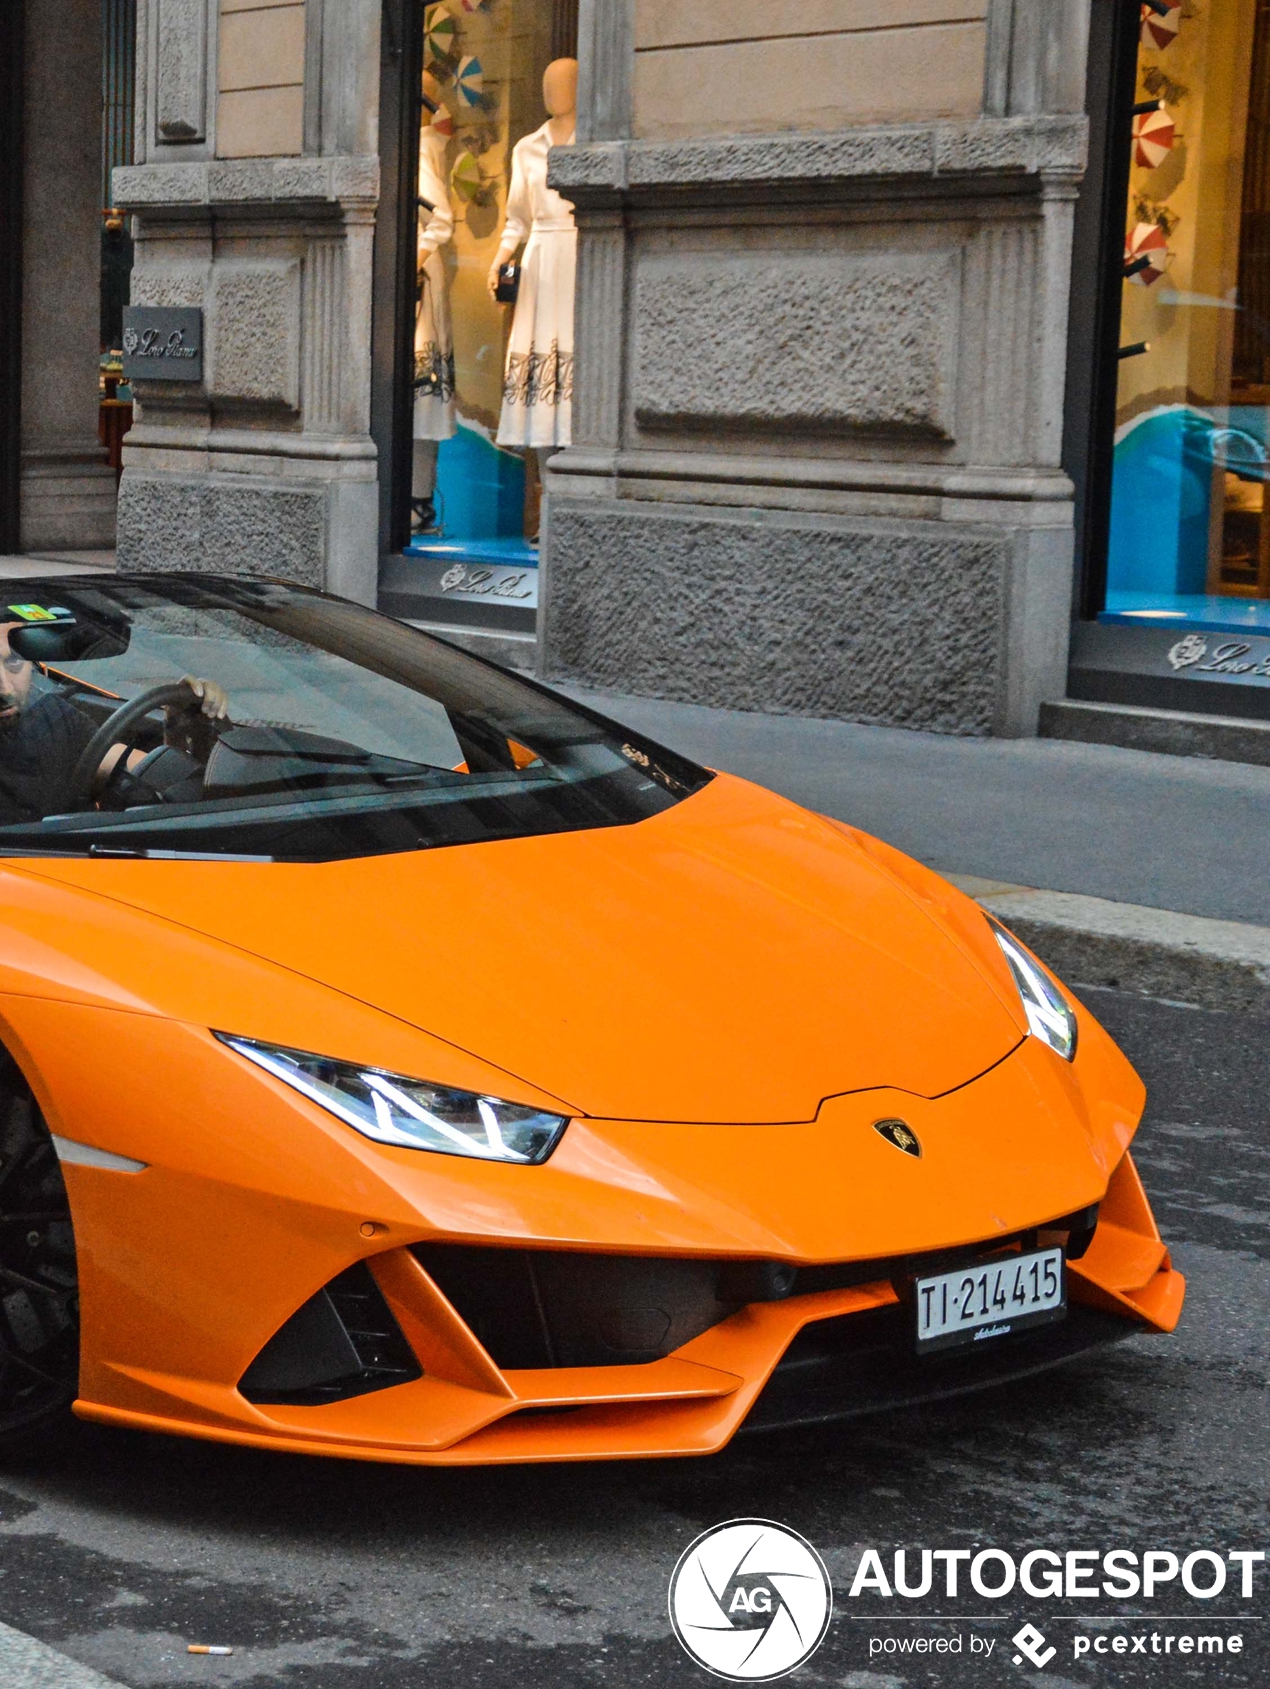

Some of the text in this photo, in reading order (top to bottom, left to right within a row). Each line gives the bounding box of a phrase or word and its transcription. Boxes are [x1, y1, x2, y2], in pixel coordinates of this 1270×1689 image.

[136, 328, 197, 357] Loro Piana
[1193, 642, 1257, 675] Loro
